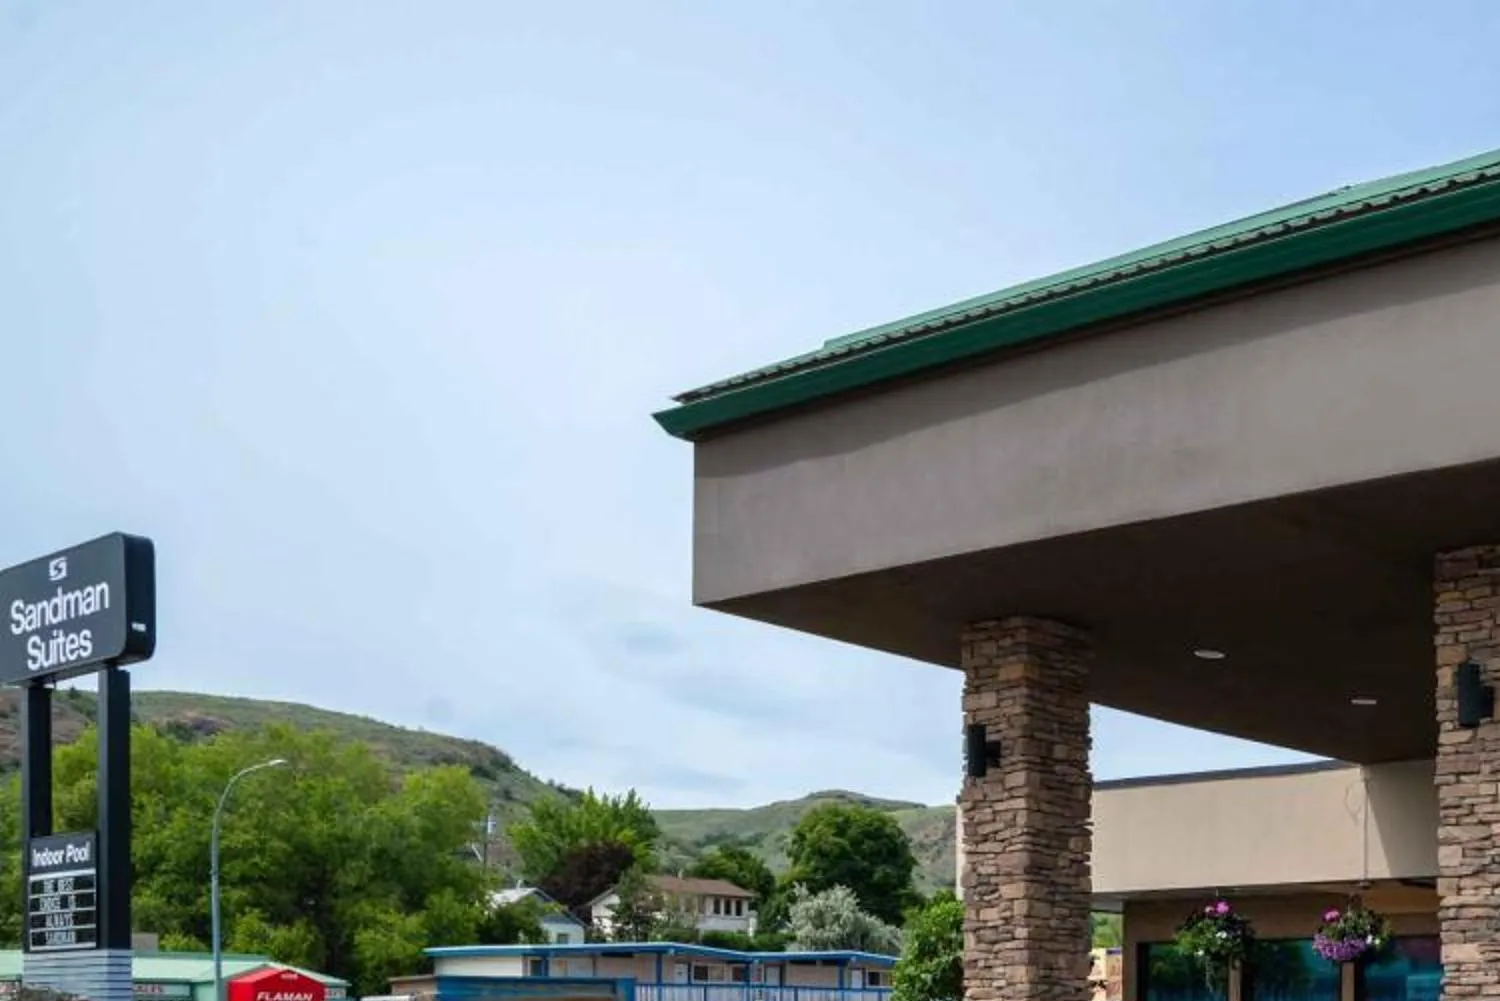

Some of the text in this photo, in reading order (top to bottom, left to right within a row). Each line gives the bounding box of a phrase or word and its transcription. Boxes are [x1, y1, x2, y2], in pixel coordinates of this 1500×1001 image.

[10, 581, 109, 635] Sandman
[27, 629, 93, 671] Suites
[32, 841, 91, 867] Indoor Pool
[256, 991, 314, 1001] FLAMAN
